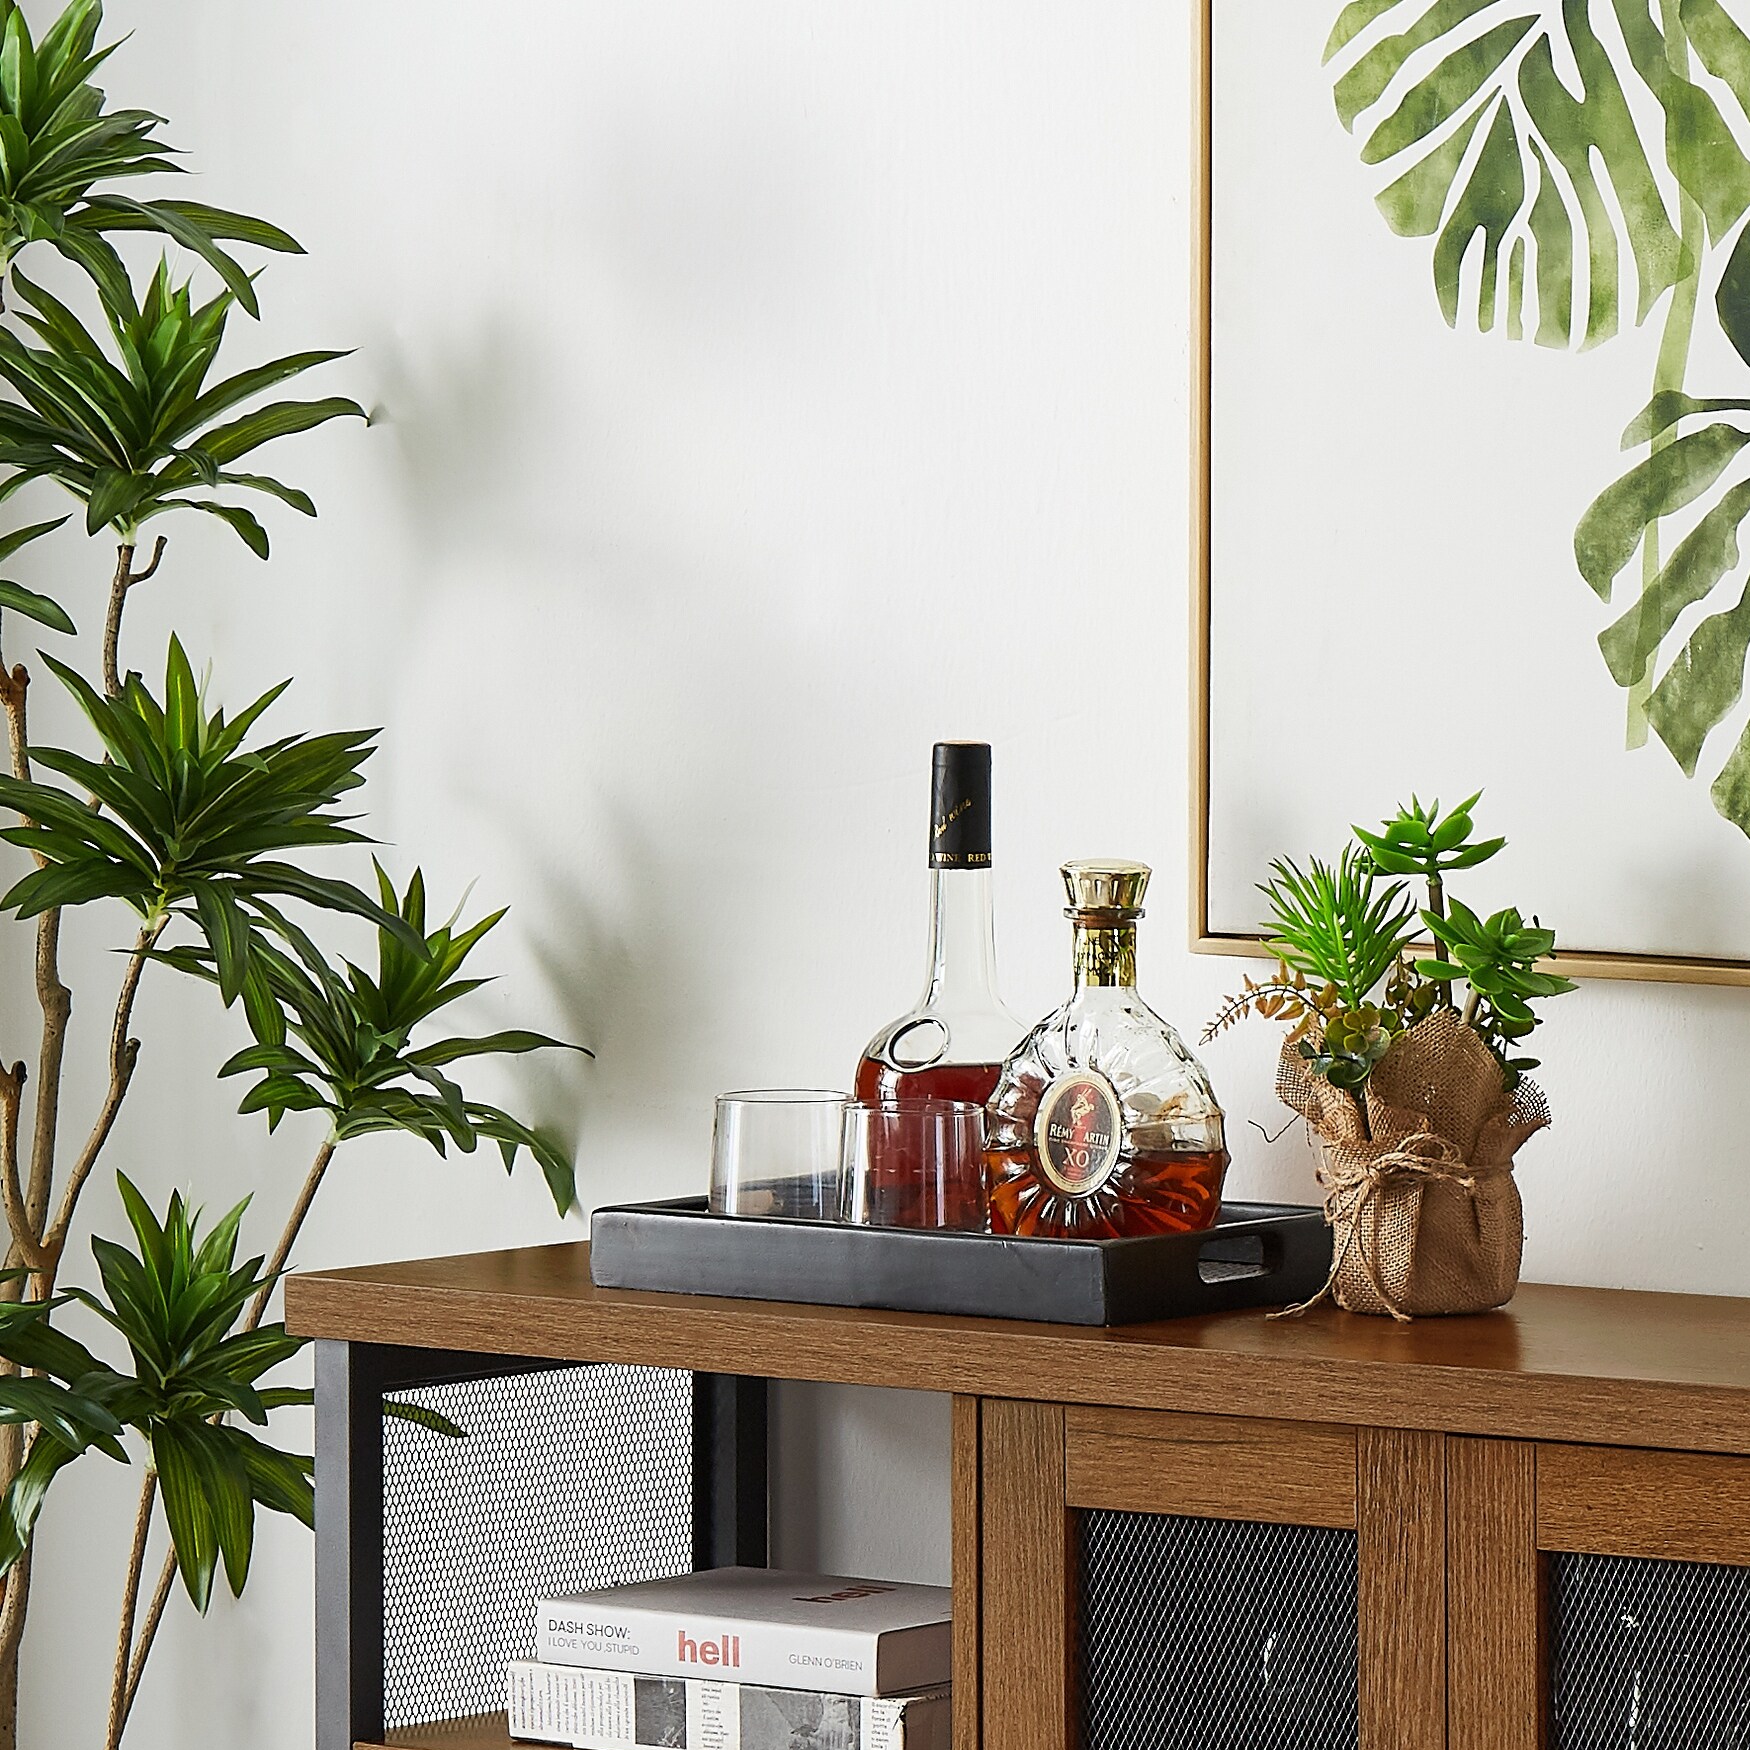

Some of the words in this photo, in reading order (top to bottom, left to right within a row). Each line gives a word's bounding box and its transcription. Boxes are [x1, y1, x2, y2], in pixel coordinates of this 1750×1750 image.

[967, 853, 987, 863] RED
[1062, 1146, 1090, 1168] XO
[548, 1619, 584, 1635] DASH
[586, 1623, 631, 1640] SHOW:
[552, 1637, 578, 1649] LOVE
[580, 1640, 602, 1652] YOU
[677, 1630, 741, 1668] hell
[789, 1653, 823, 1667] GLENN
[824, 1658, 863, 1672] O'BRIEN
